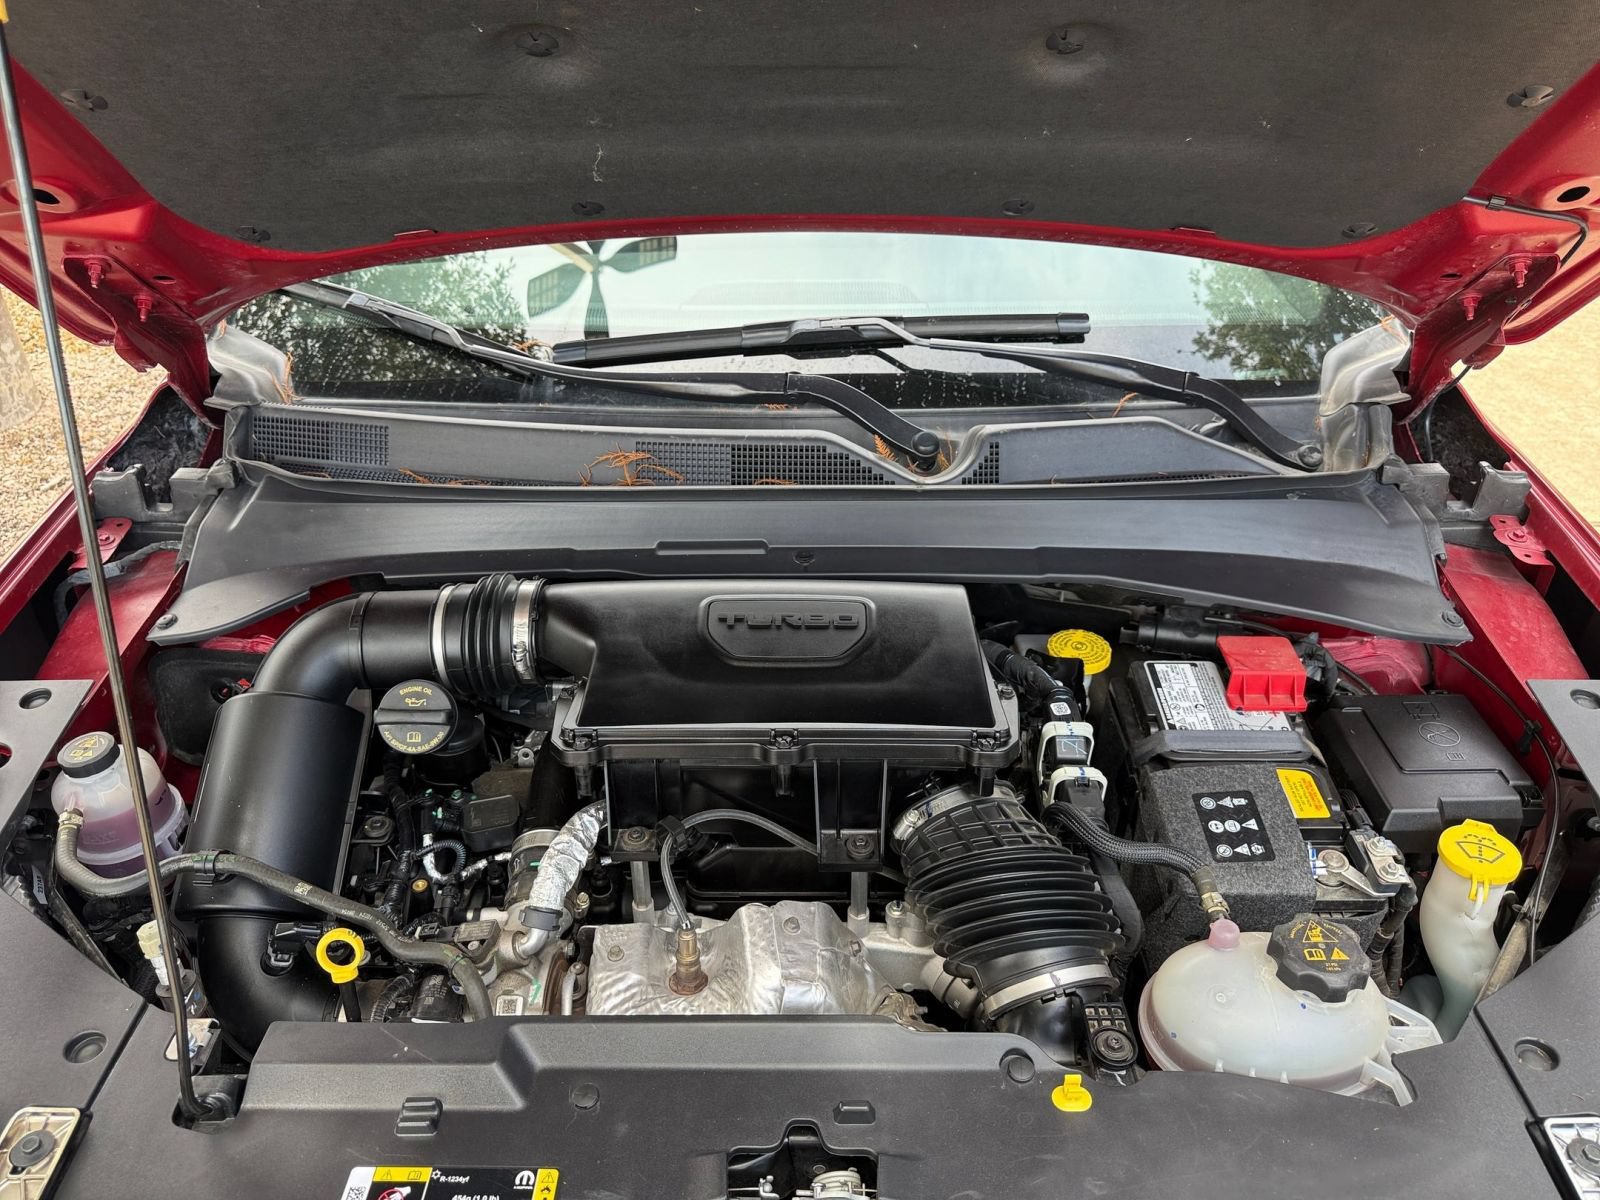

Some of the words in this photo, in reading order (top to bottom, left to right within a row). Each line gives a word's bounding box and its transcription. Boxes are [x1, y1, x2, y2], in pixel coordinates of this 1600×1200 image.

[718, 611, 859, 629] TURBO
[399, 686, 422, 696] ENGINE
[423, 687, 433, 696] OIL
[439, 1175, 470, 1184] R-1234yf
